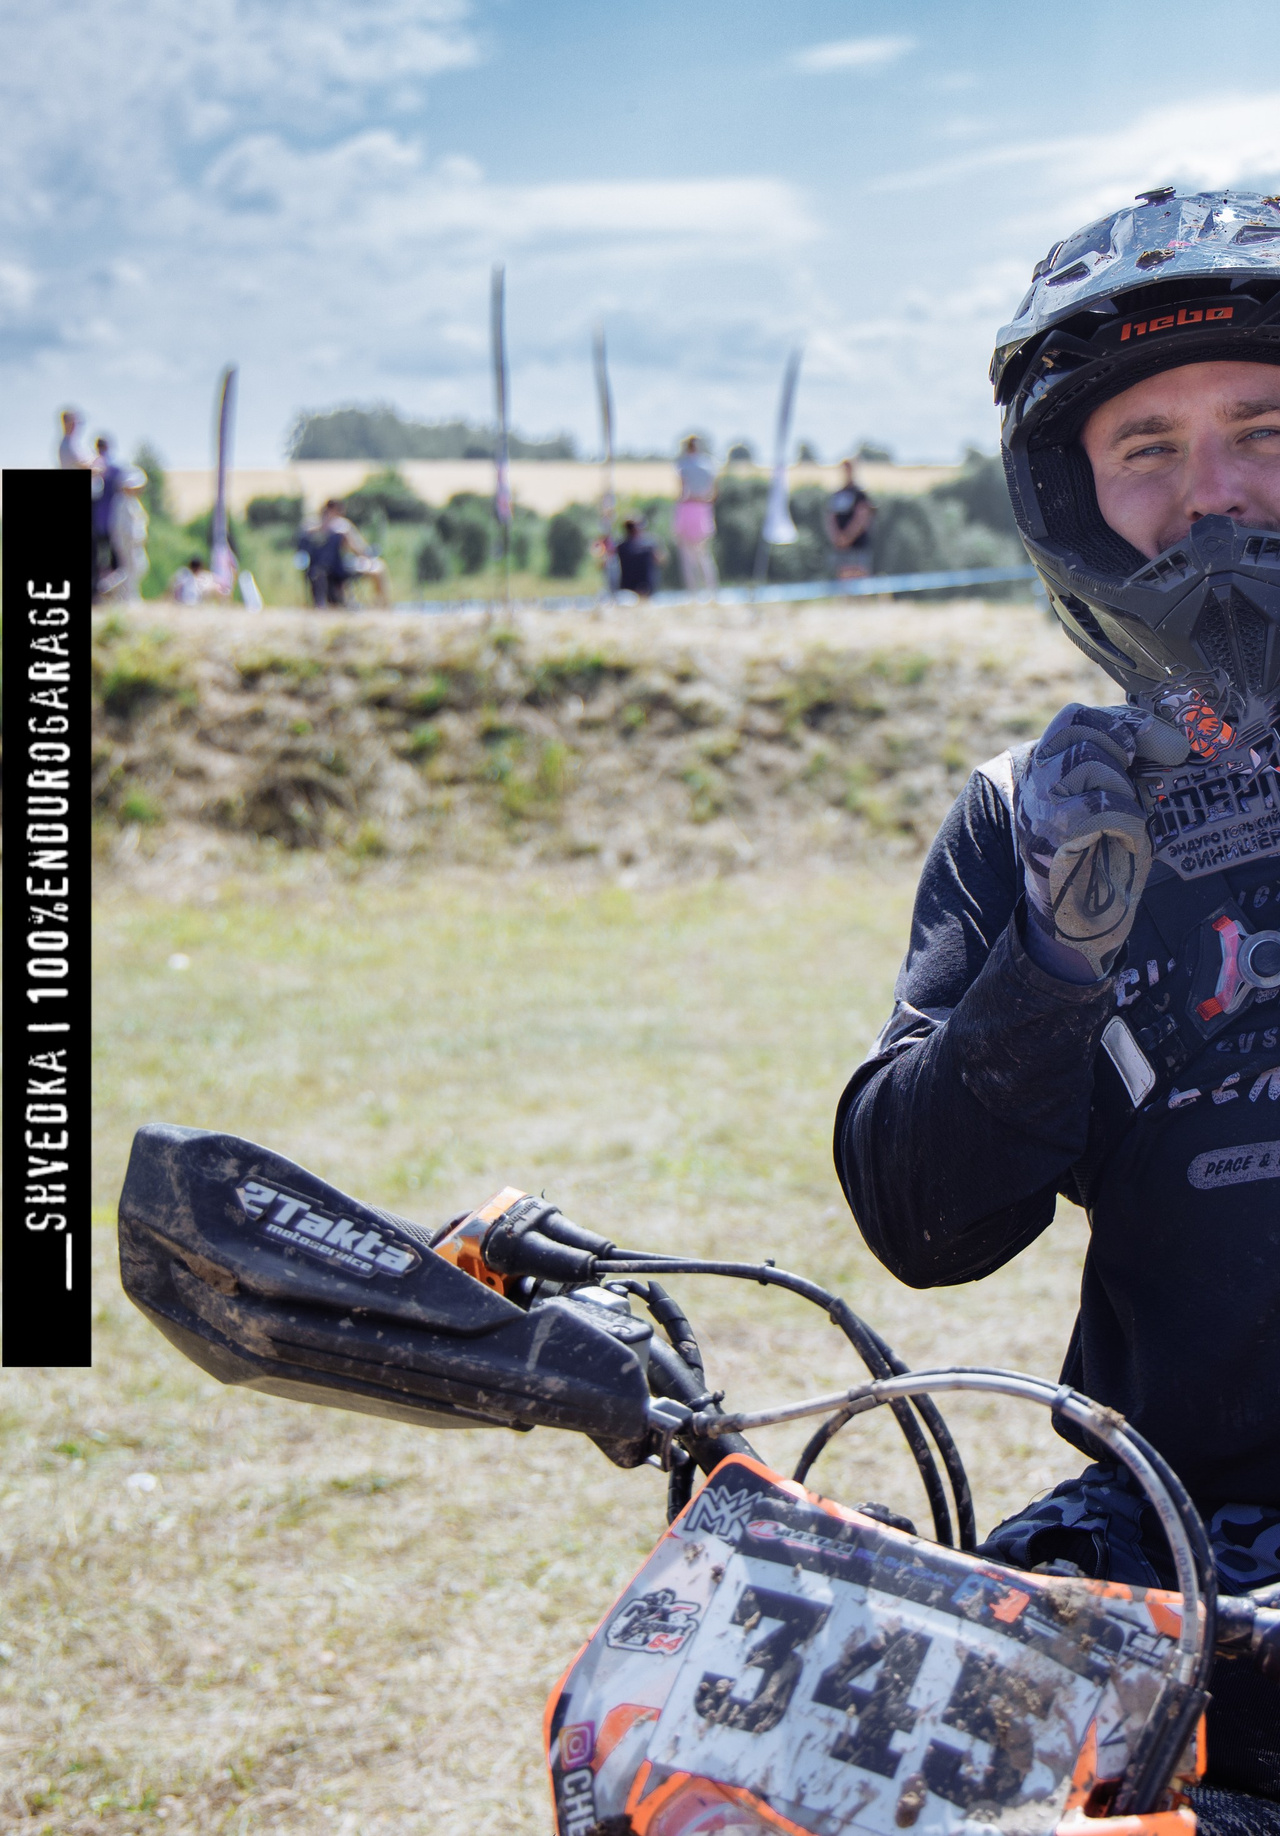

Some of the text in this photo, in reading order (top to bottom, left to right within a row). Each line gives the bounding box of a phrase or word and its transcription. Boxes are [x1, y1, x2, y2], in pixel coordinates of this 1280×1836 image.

[1120, 306, 1234, 342] hebo
[1167, 831, 1221, 858] ЭНДУРО
[1204, 1152, 1254, 1178] PEACE
[1260, 1151, 1272, 1168] &
[243, 1180, 416, 1274] 2Takta
[265, 1222, 374, 1273] motoservice
[695, 1583, 1058, 1812] 345
